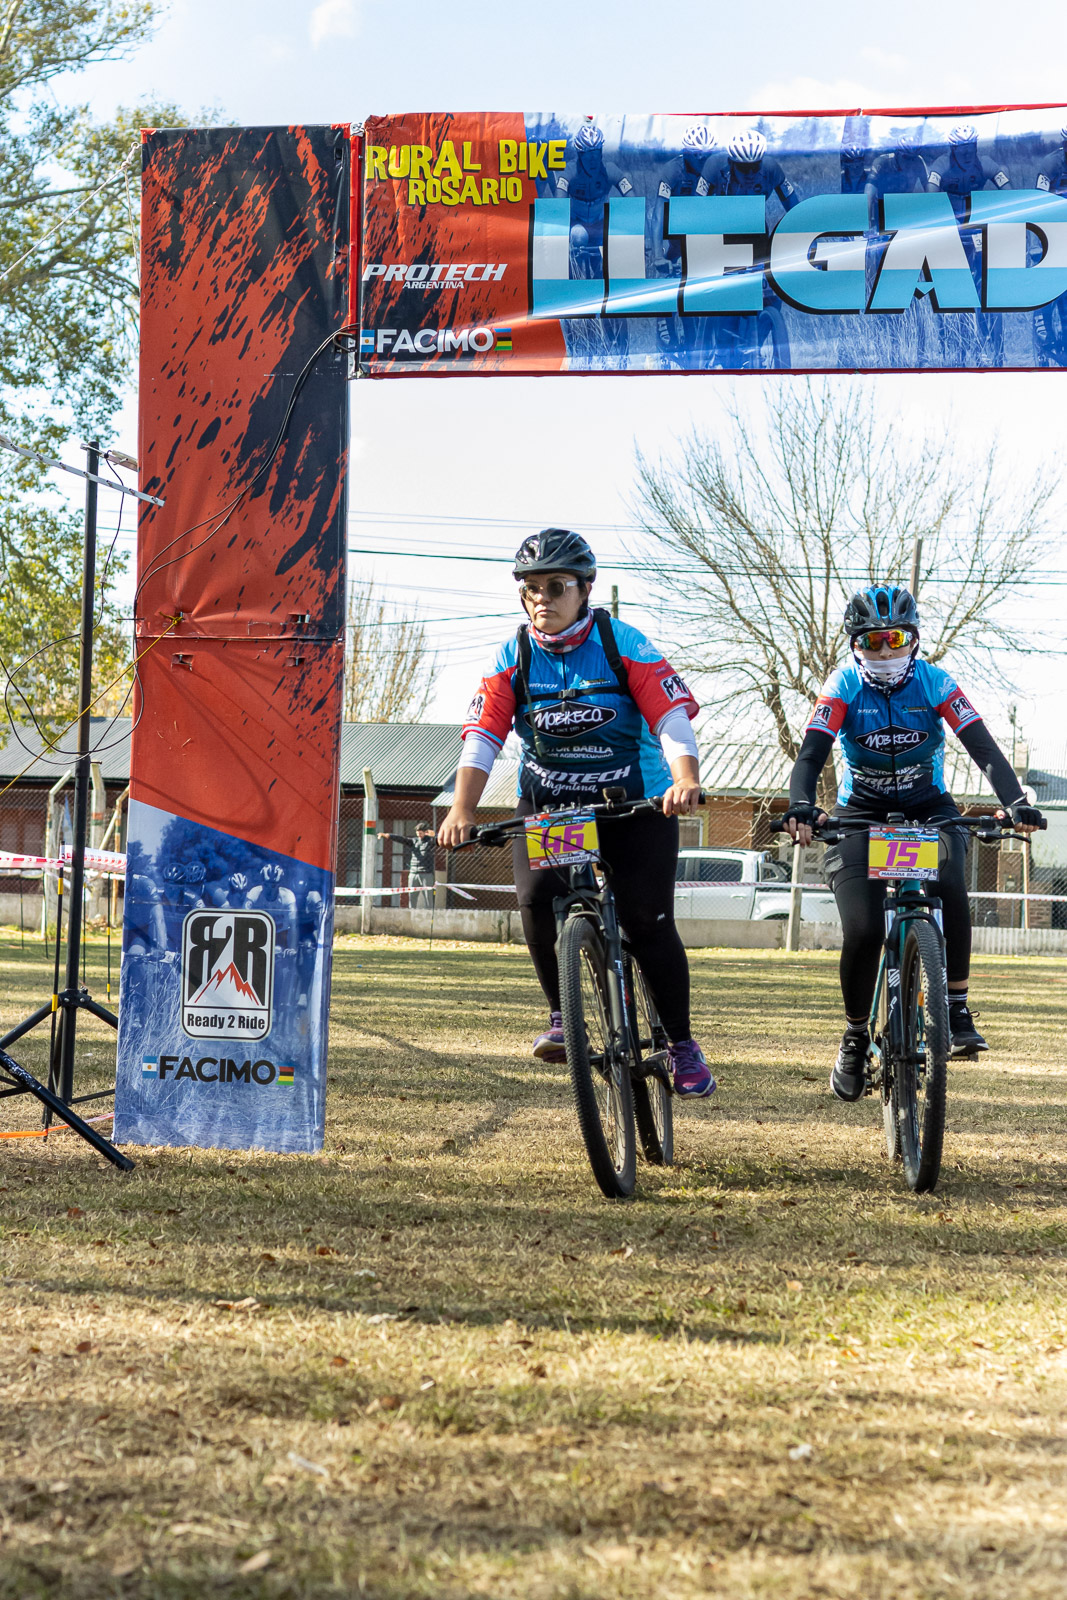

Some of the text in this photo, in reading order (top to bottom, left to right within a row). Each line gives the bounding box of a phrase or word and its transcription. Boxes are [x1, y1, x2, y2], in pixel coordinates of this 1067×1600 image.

[365, 139, 567, 180] RURAL BIKE
[408, 176, 523, 206] ROSARIO
[527, 189, 1067, 320] LLEGAD
[361, 263, 508, 281] PROTECH
[402, 281, 465, 290] ARGENTINA
[377, 327, 494, 353] FACIMO
[525, 760, 631, 783] PROTECH
[540, 823, 585, 854] 46
[885, 841, 921, 867] 15
[187, 1012, 265, 1030] Ready 2 Ride
[159, 1055, 276, 1085] FACIMO
